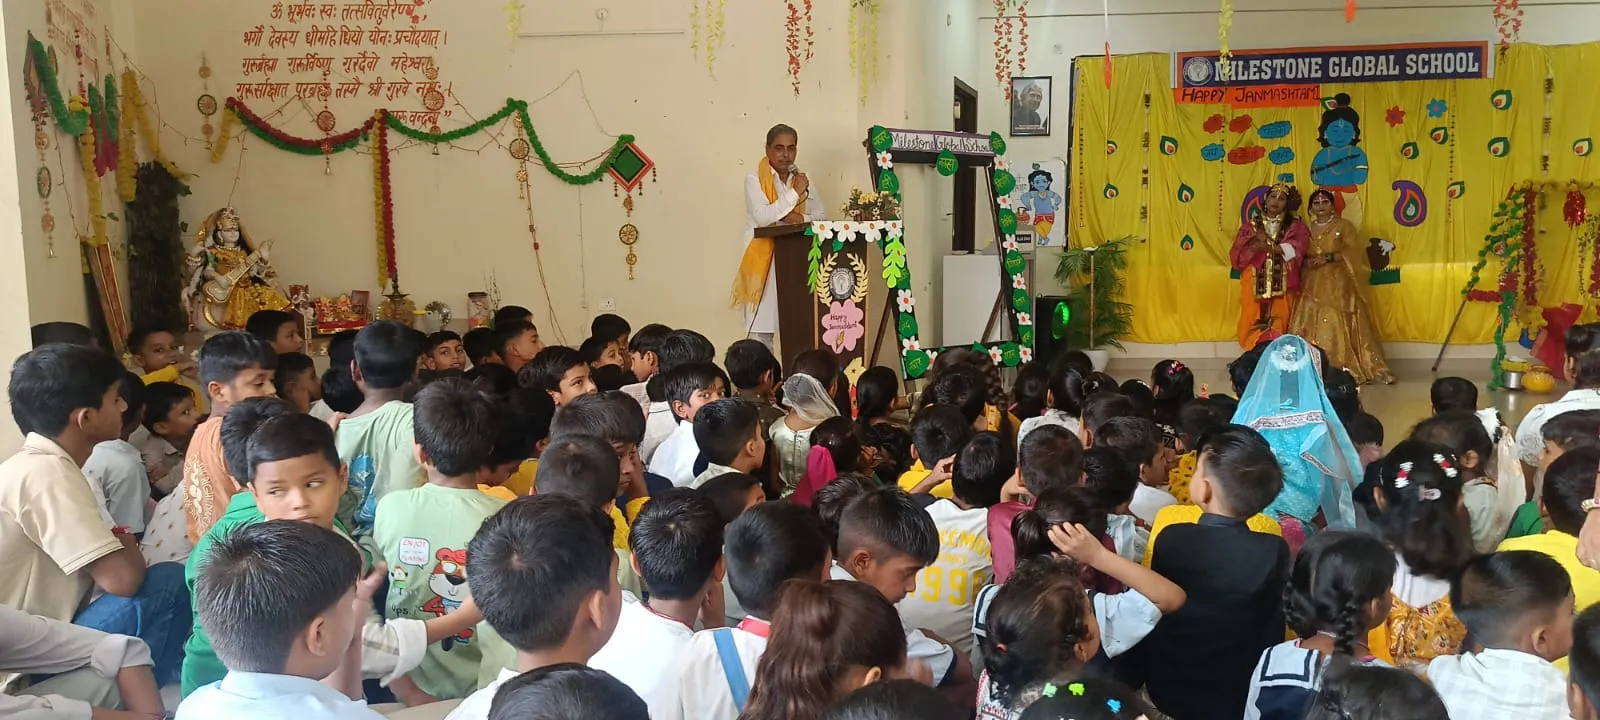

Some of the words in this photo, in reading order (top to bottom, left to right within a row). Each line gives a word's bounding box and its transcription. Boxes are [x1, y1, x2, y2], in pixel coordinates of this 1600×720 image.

[320, 4, 337, 20] स्वः
[268, 26, 300, 48] देवस्य
[305, 25, 337, 47] धीमहि
[339, 25, 365, 46] धियो
[1214, 57, 1322, 82] MILESTONE
[1328, 55, 1400, 78] GLOBAL
[1405, 51, 1479, 76] SCHOOL
[368, 76, 385, 97] श्री
[1181, 87, 1225, 103] HAPPY
[1235, 84, 1321, 103] JANMASHTAMI
